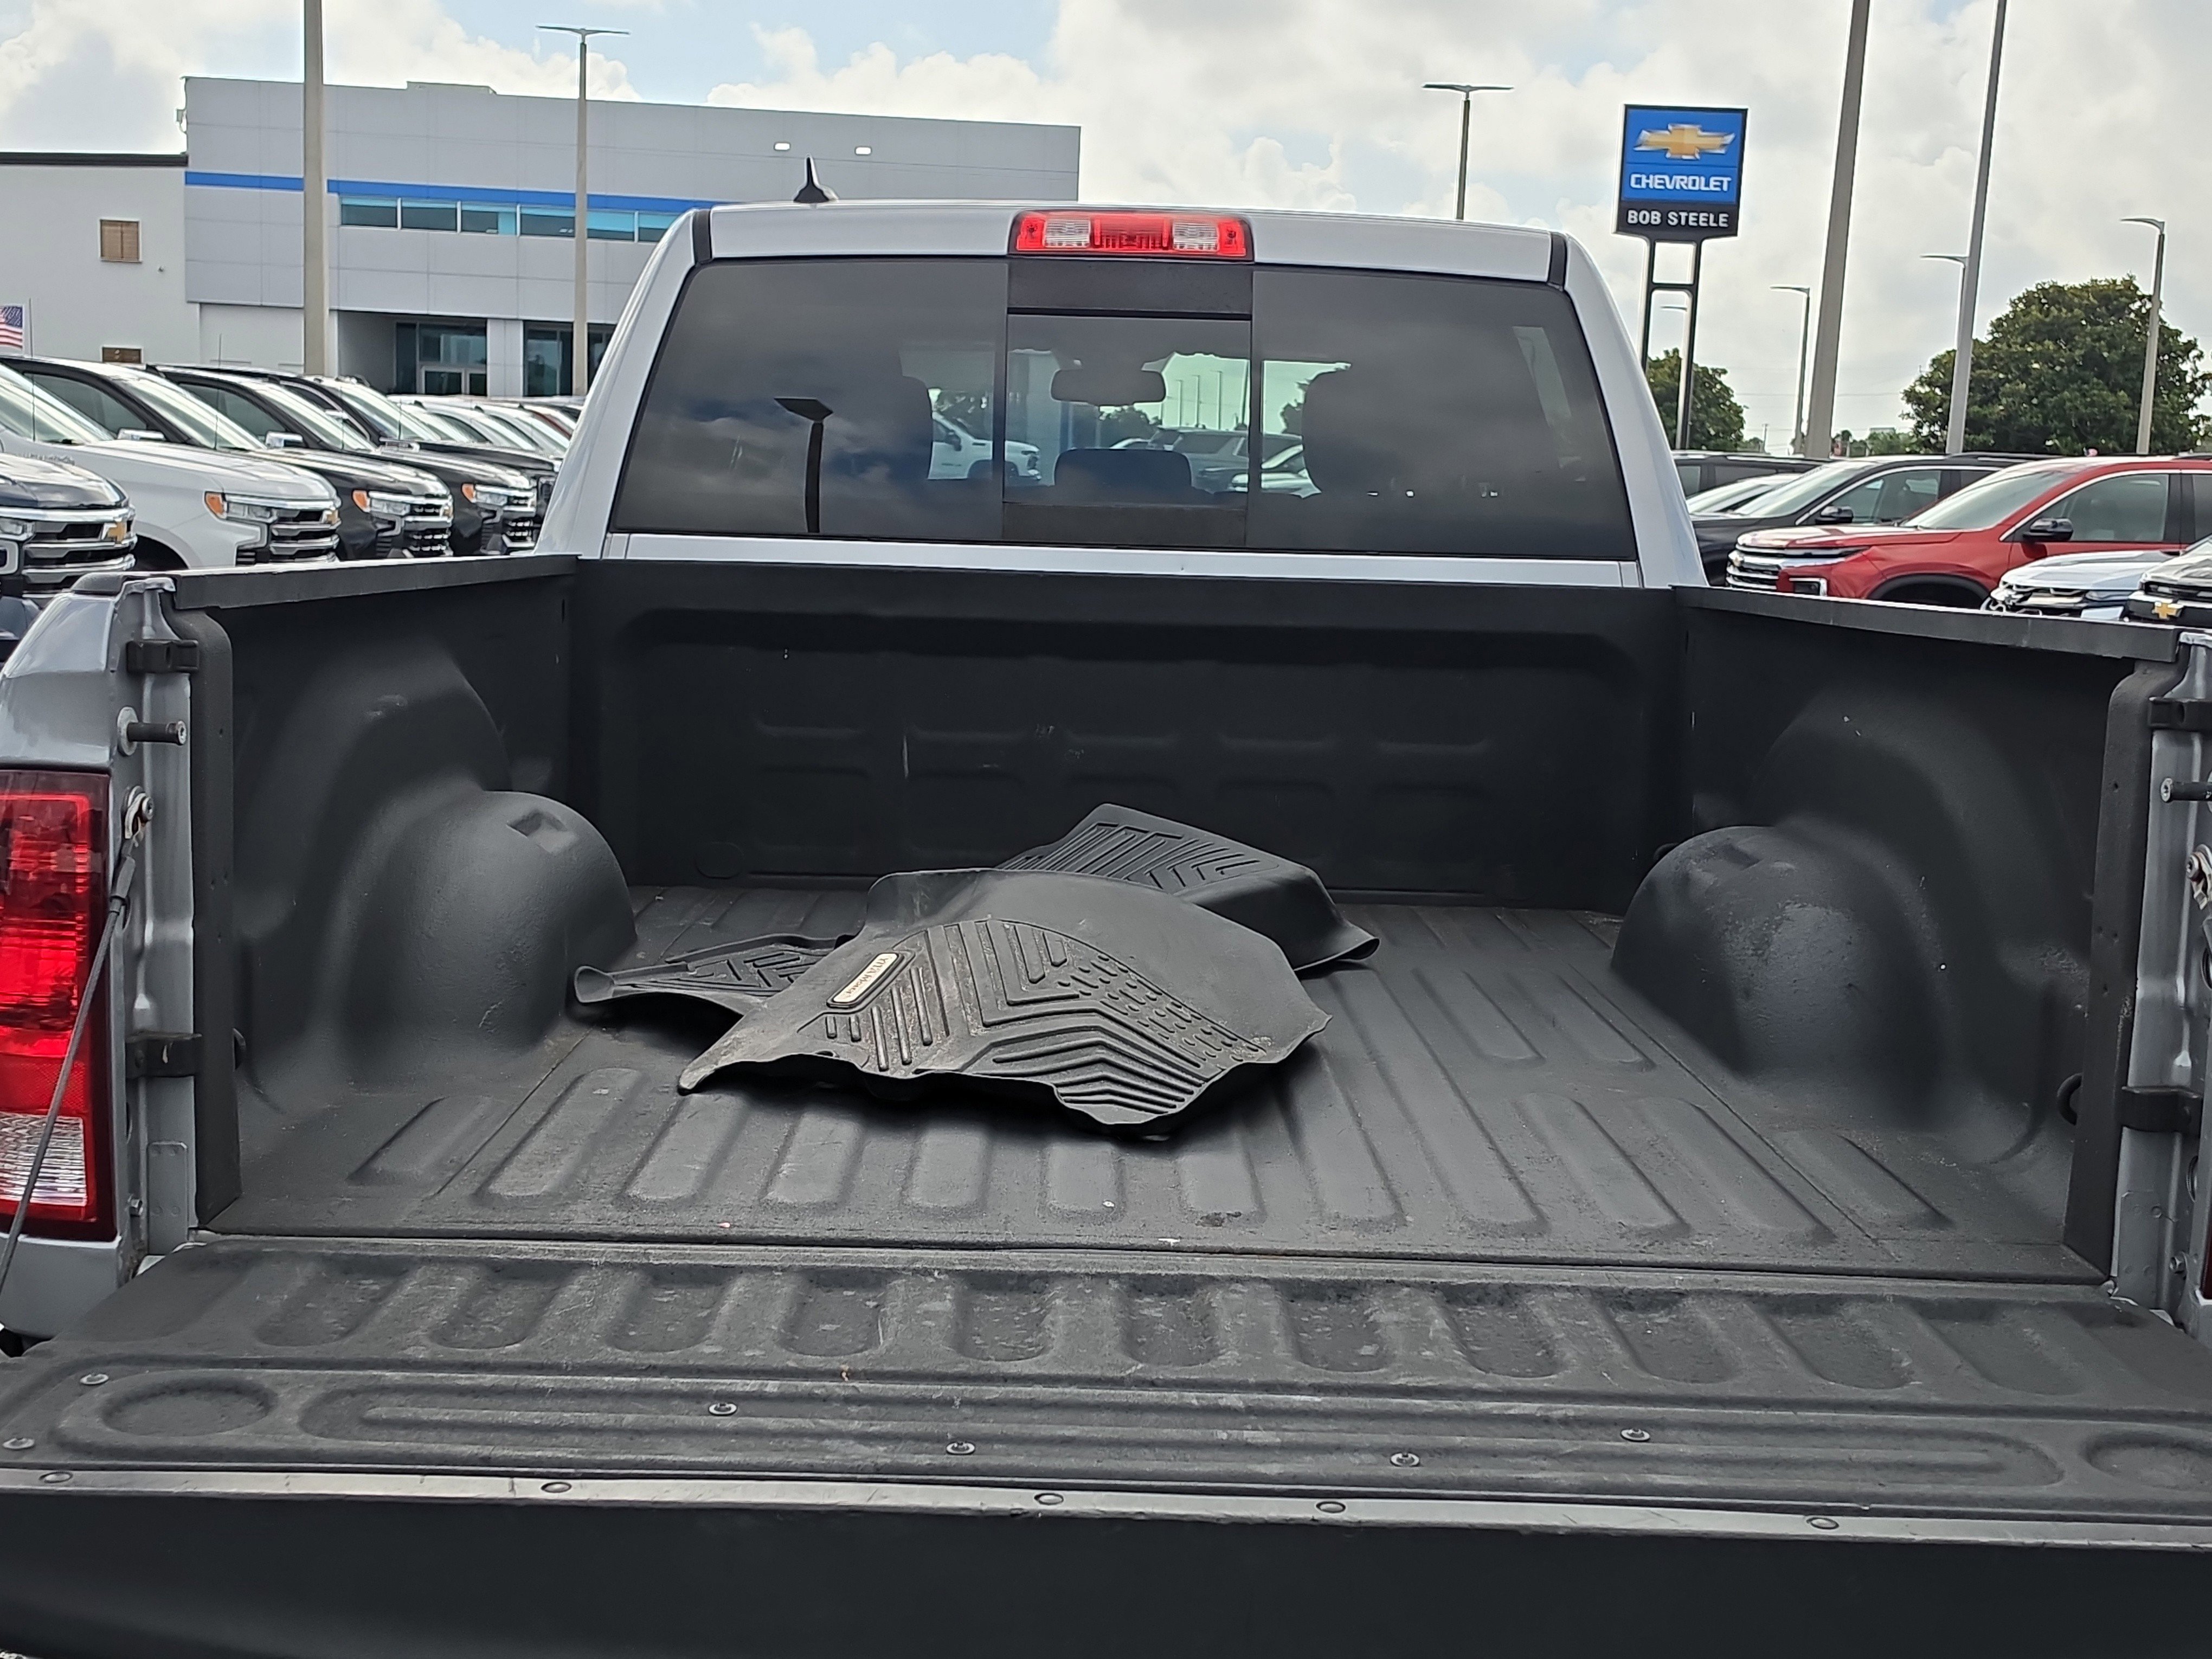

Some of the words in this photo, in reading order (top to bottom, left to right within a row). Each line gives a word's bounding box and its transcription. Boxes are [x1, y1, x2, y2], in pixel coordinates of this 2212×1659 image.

[1630, 173, 1732, 191] CHEVROLET
[1627, 210, 1662, 224] BOB
[1667, 211, 1729, 227] STEELE
